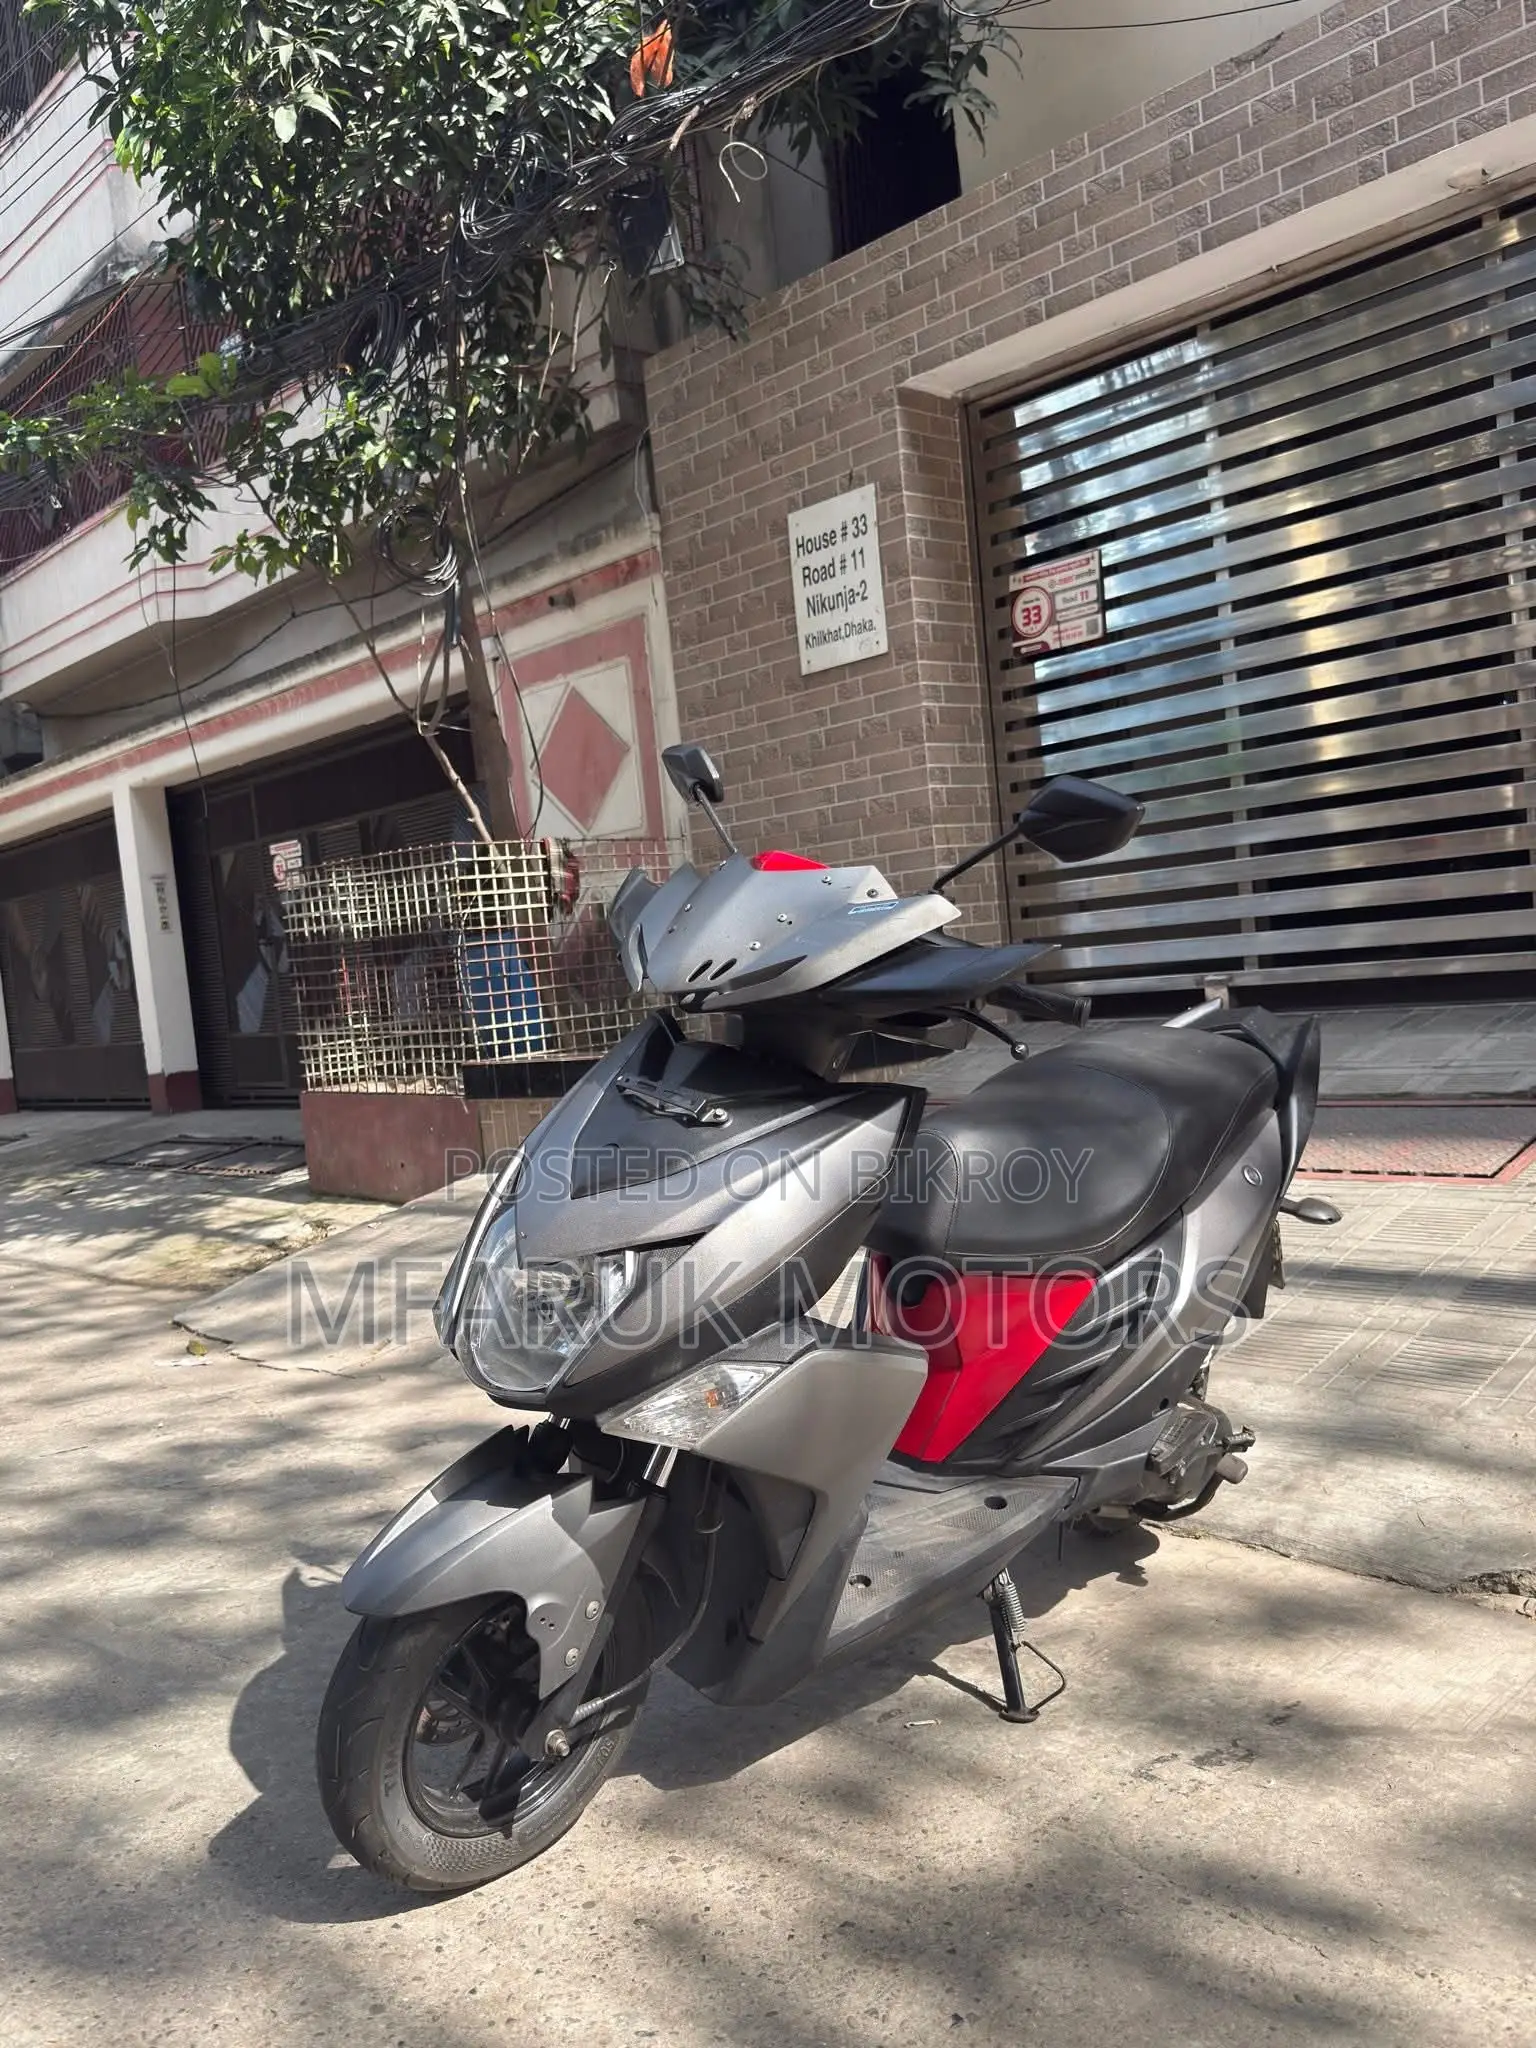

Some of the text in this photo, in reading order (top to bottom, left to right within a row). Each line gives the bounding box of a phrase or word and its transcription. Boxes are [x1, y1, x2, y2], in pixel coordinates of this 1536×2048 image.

[795, 513, 868, 558] House # 33
[801, 547, 866, 588] Road # 11
[805, 579, 869, 619] Nikunja-2
[1022, 604, 1042, 628] 33
